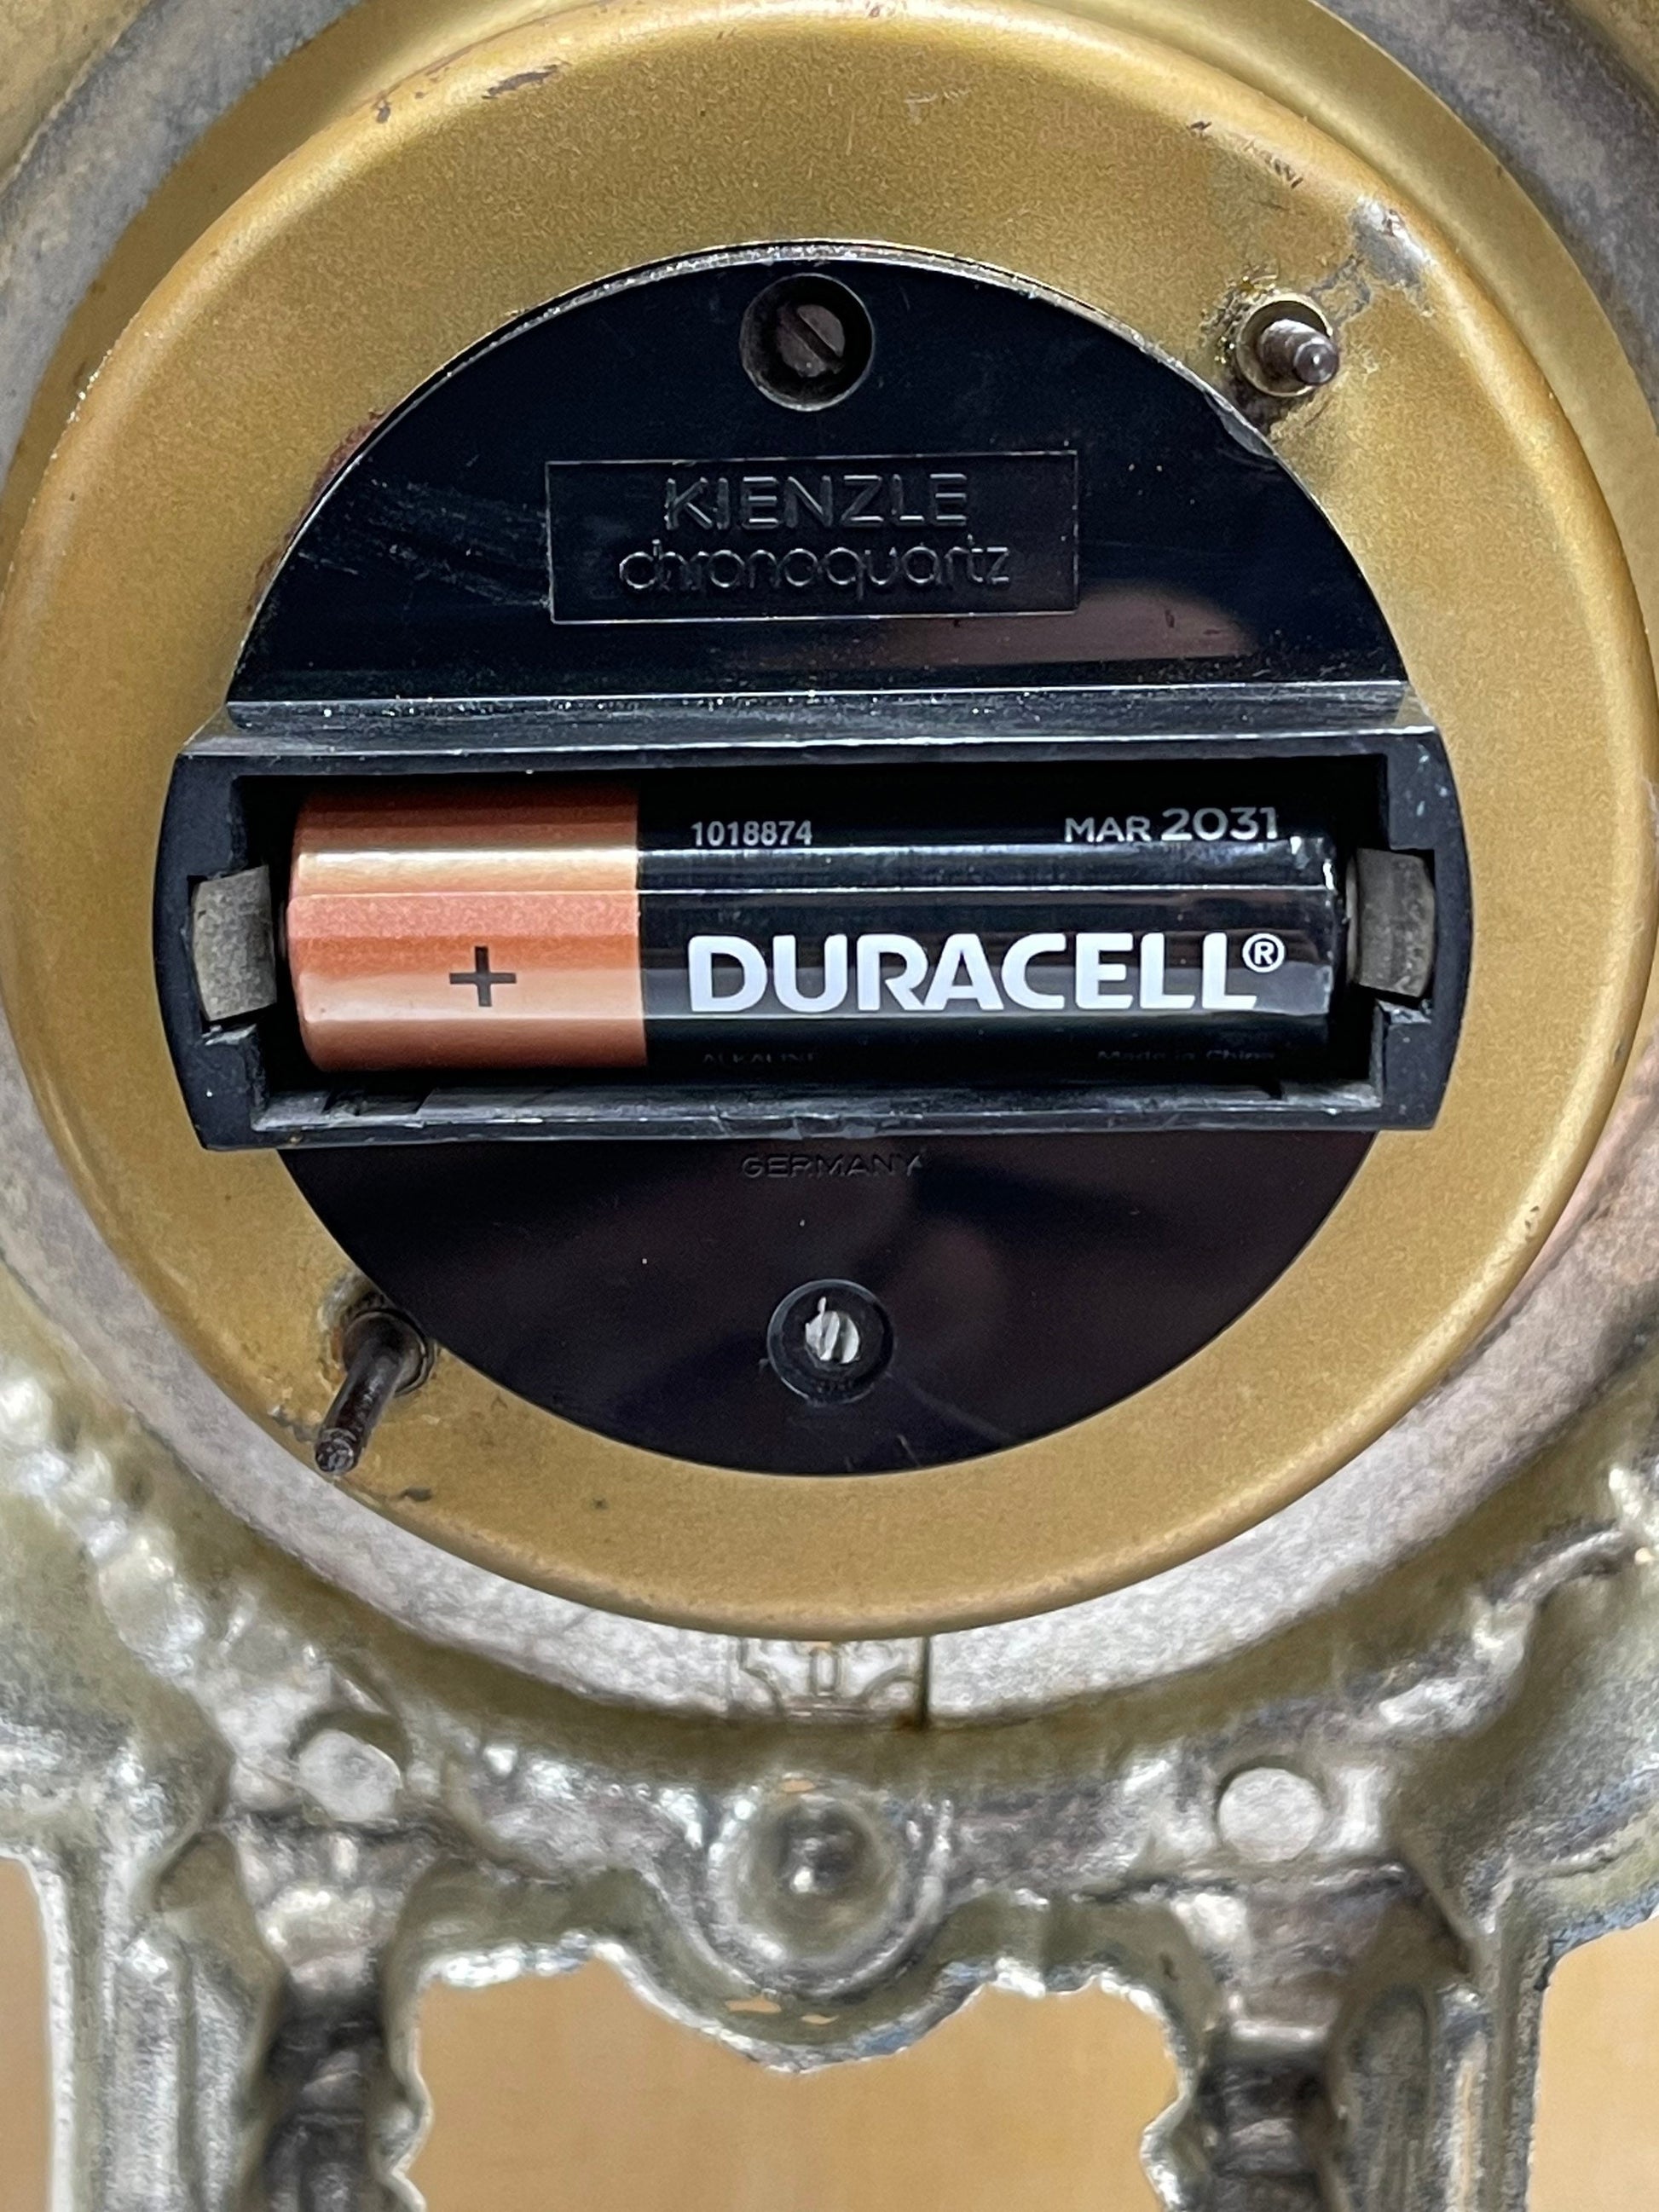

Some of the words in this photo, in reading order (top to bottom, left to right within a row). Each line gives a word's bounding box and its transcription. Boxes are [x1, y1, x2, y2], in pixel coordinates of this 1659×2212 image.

[663, 473, 969, 530] KIENZLE
[618, 534, 1011, 599] chronoquartz
[690, 820, 813, 846] 1018874
[1065, 816, 1152, 843] MAR
[1160, 806, 1279, 842] 2031
[740, 1152, 924, 1179] GERMANY
